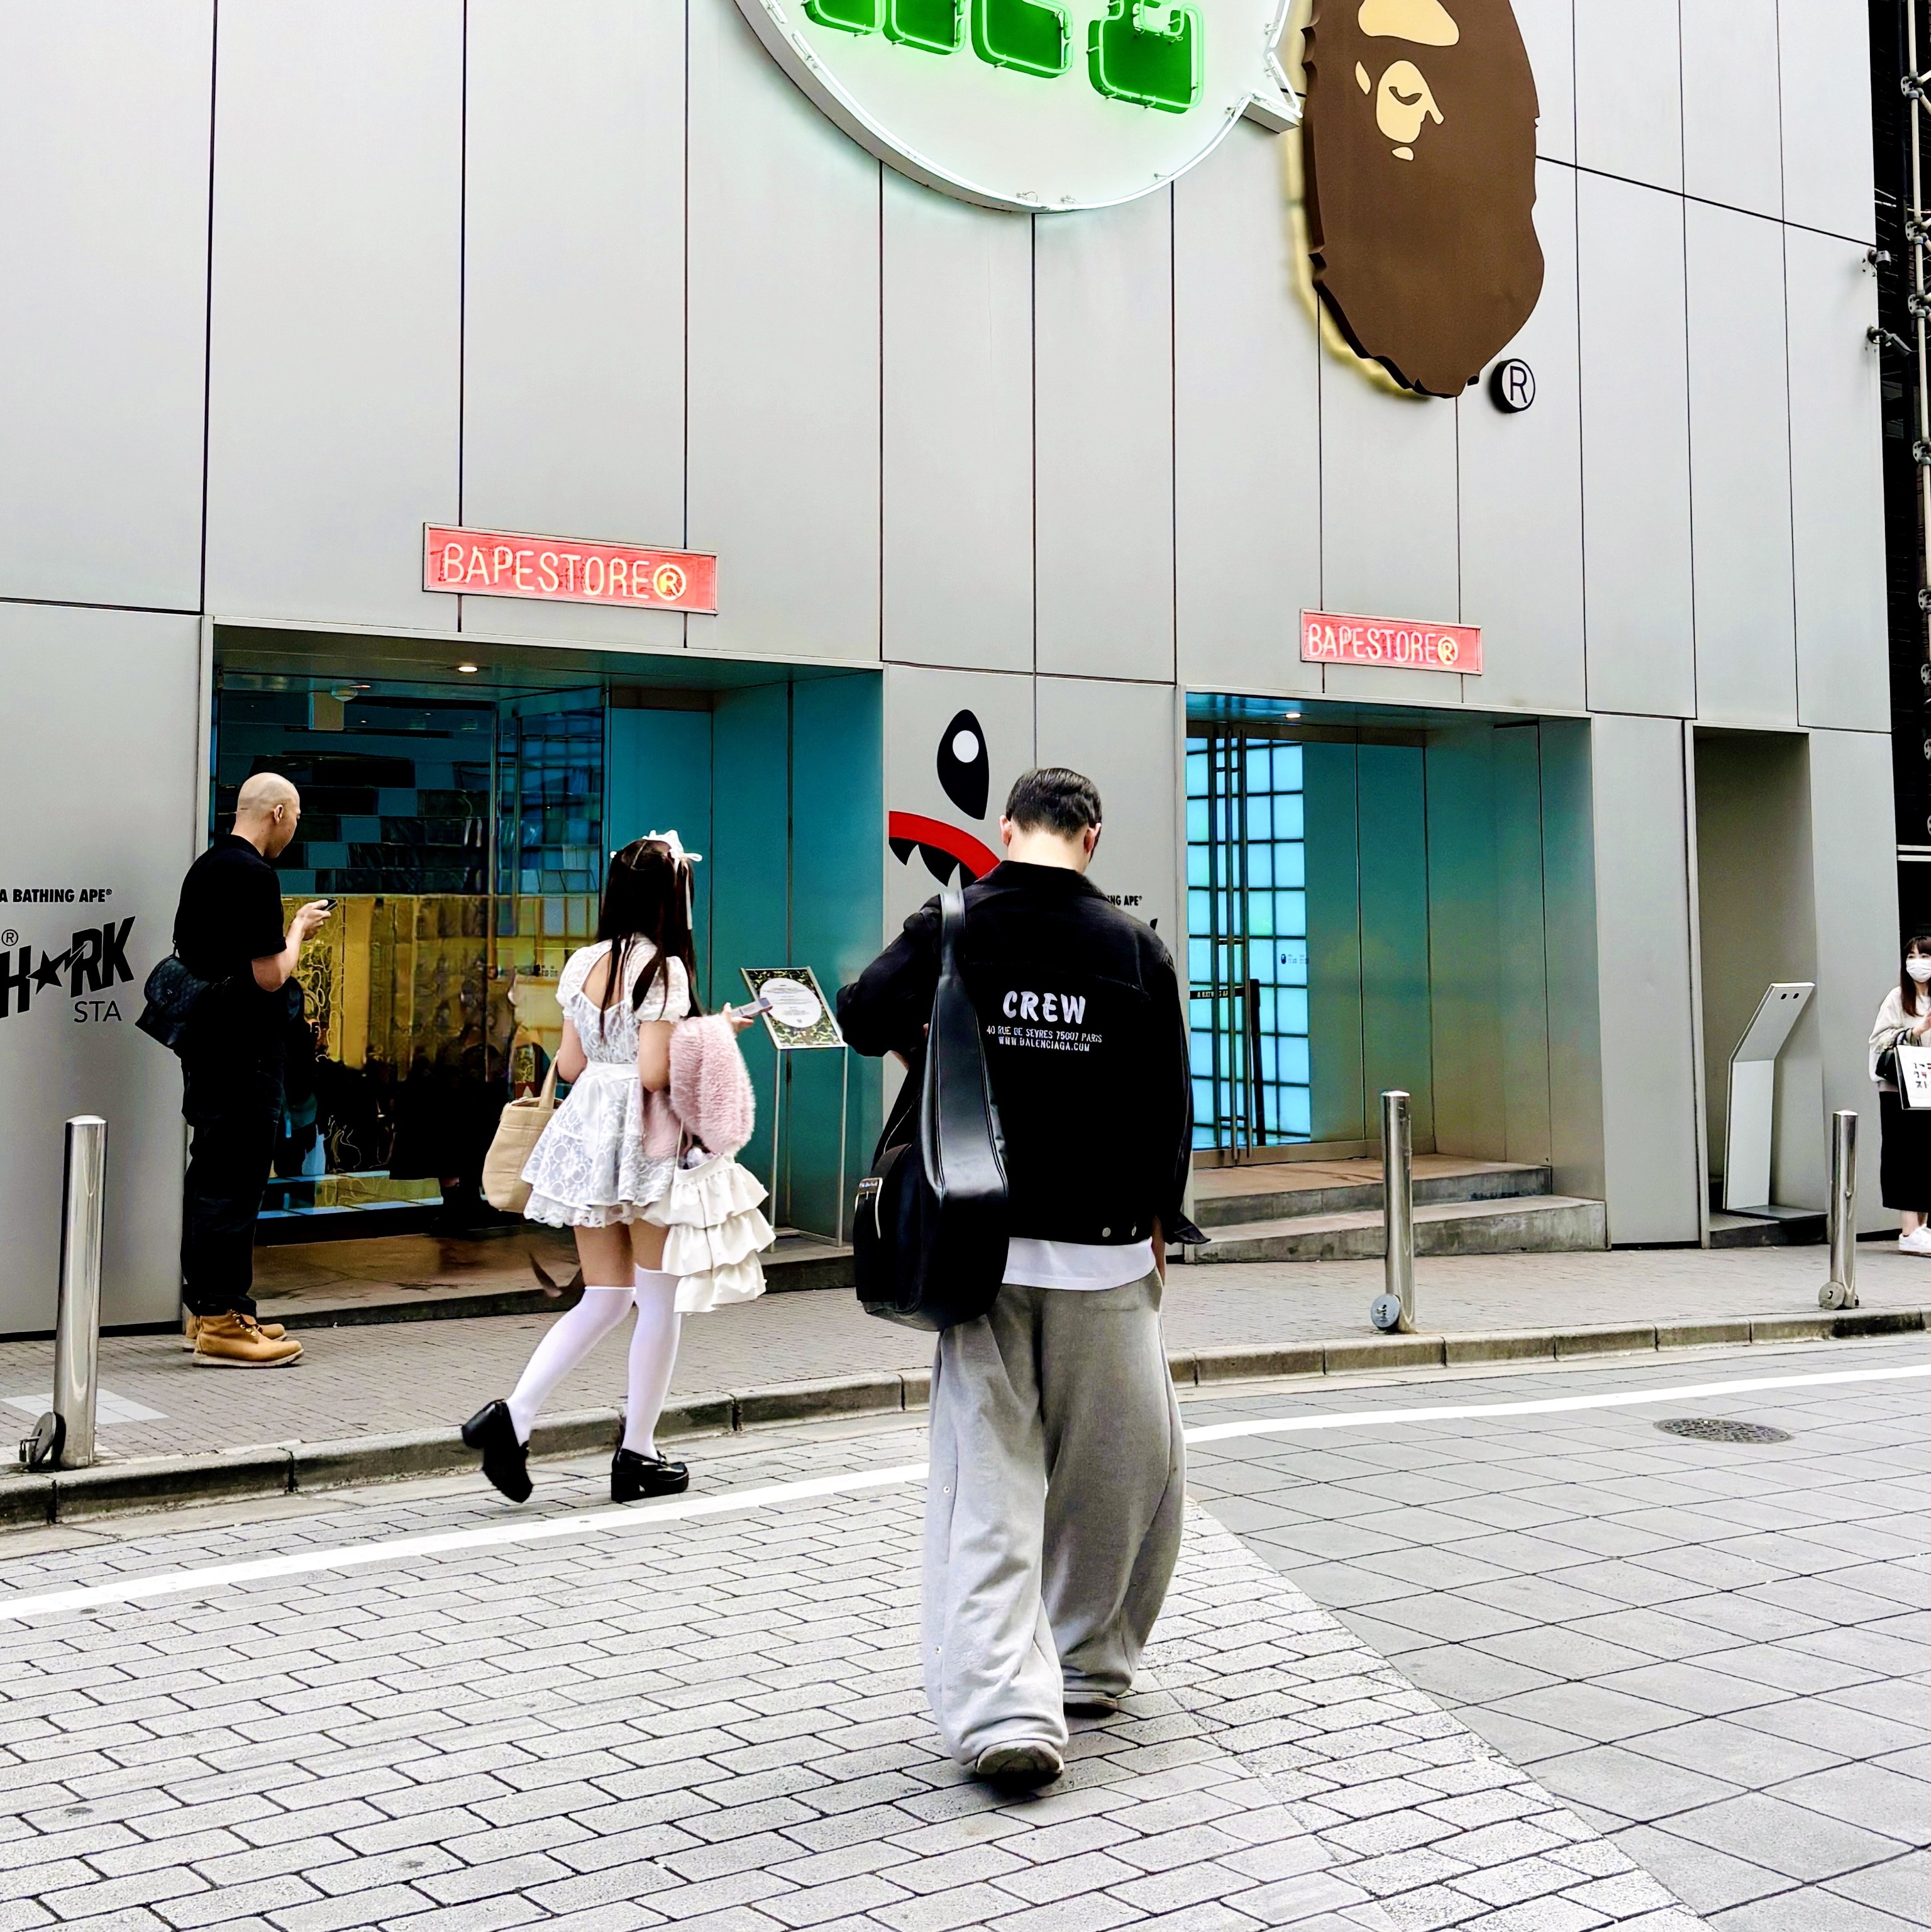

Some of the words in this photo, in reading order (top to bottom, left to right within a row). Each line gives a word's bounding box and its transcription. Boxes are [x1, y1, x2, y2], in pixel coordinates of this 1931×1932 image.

[13, 889, 75, 902] BATHING
[74, 1000, 122, 1023] STA
[1002, 991, 1086, 1024] CREW
[998, 1026, 1011, 1035] RUE
[1014, 1027, 1023, 1036] DE
[1026, 1028, 1053, 1039] SEVRES
[1082, 1033, 1102, 1043] PARIS
